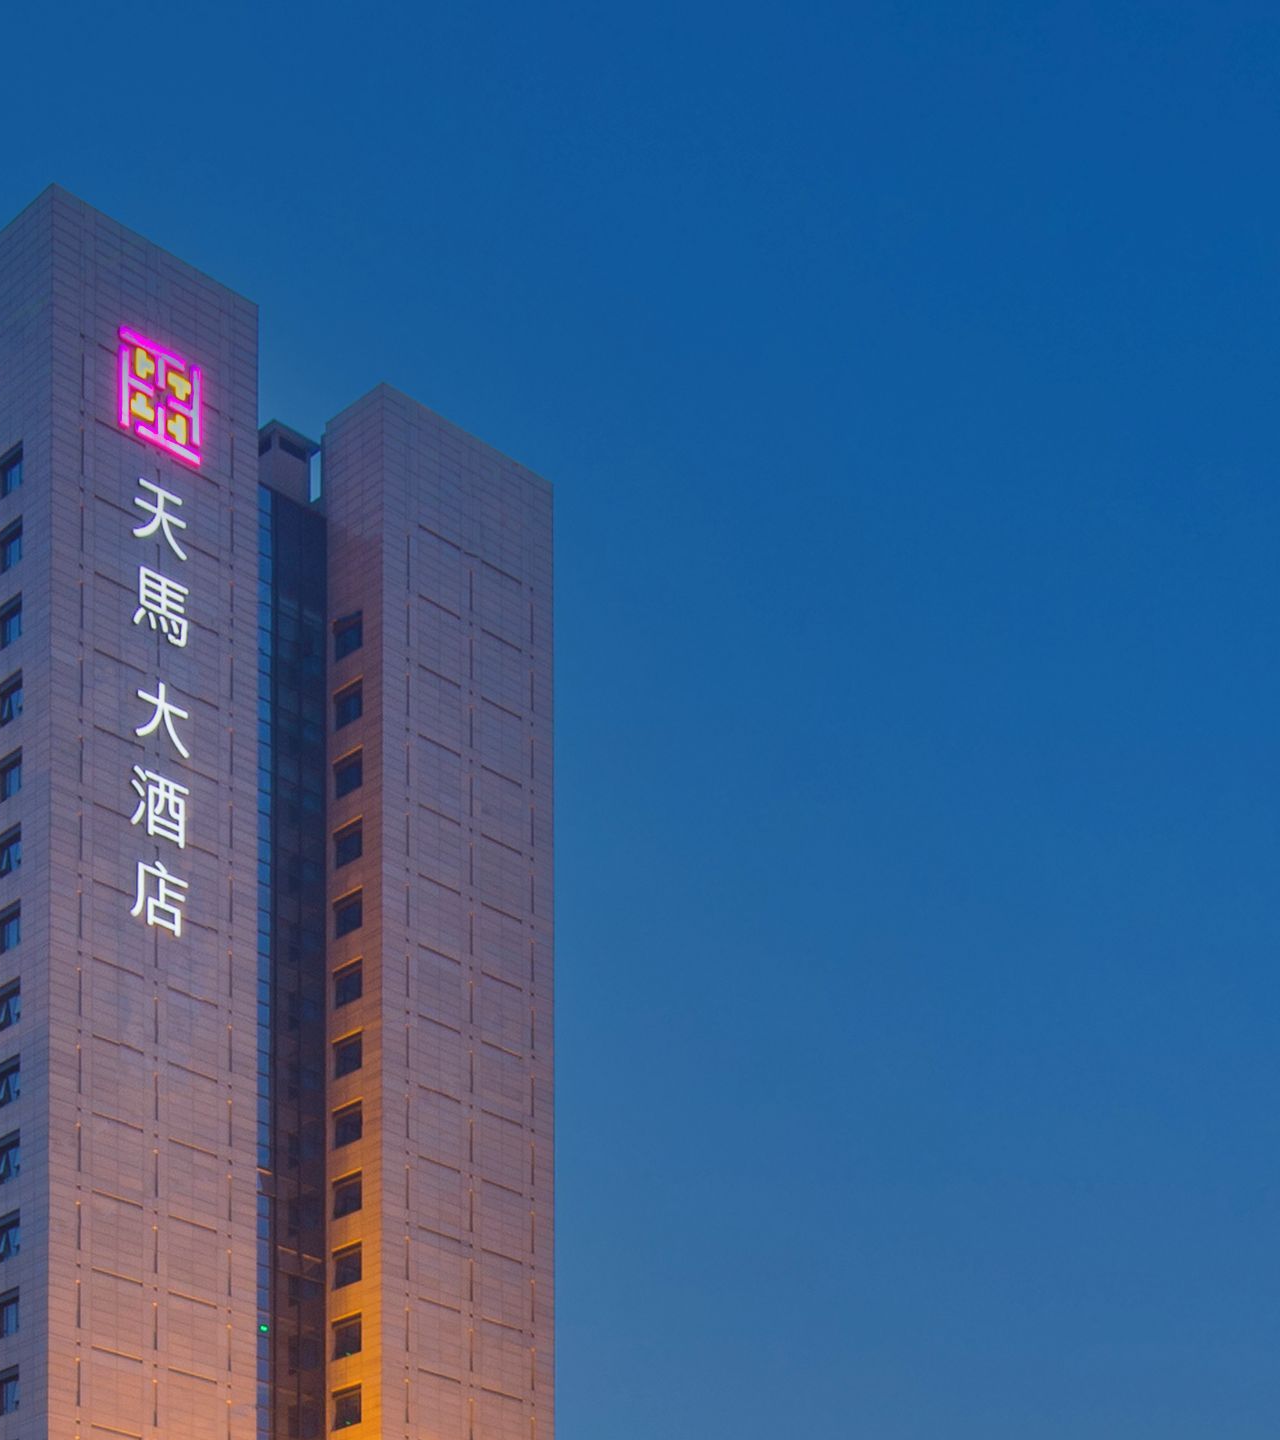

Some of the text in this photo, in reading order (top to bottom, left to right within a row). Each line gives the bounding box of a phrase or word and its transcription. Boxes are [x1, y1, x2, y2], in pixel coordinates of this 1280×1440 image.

[130, 477, 189, 938] 天馬大酒店
